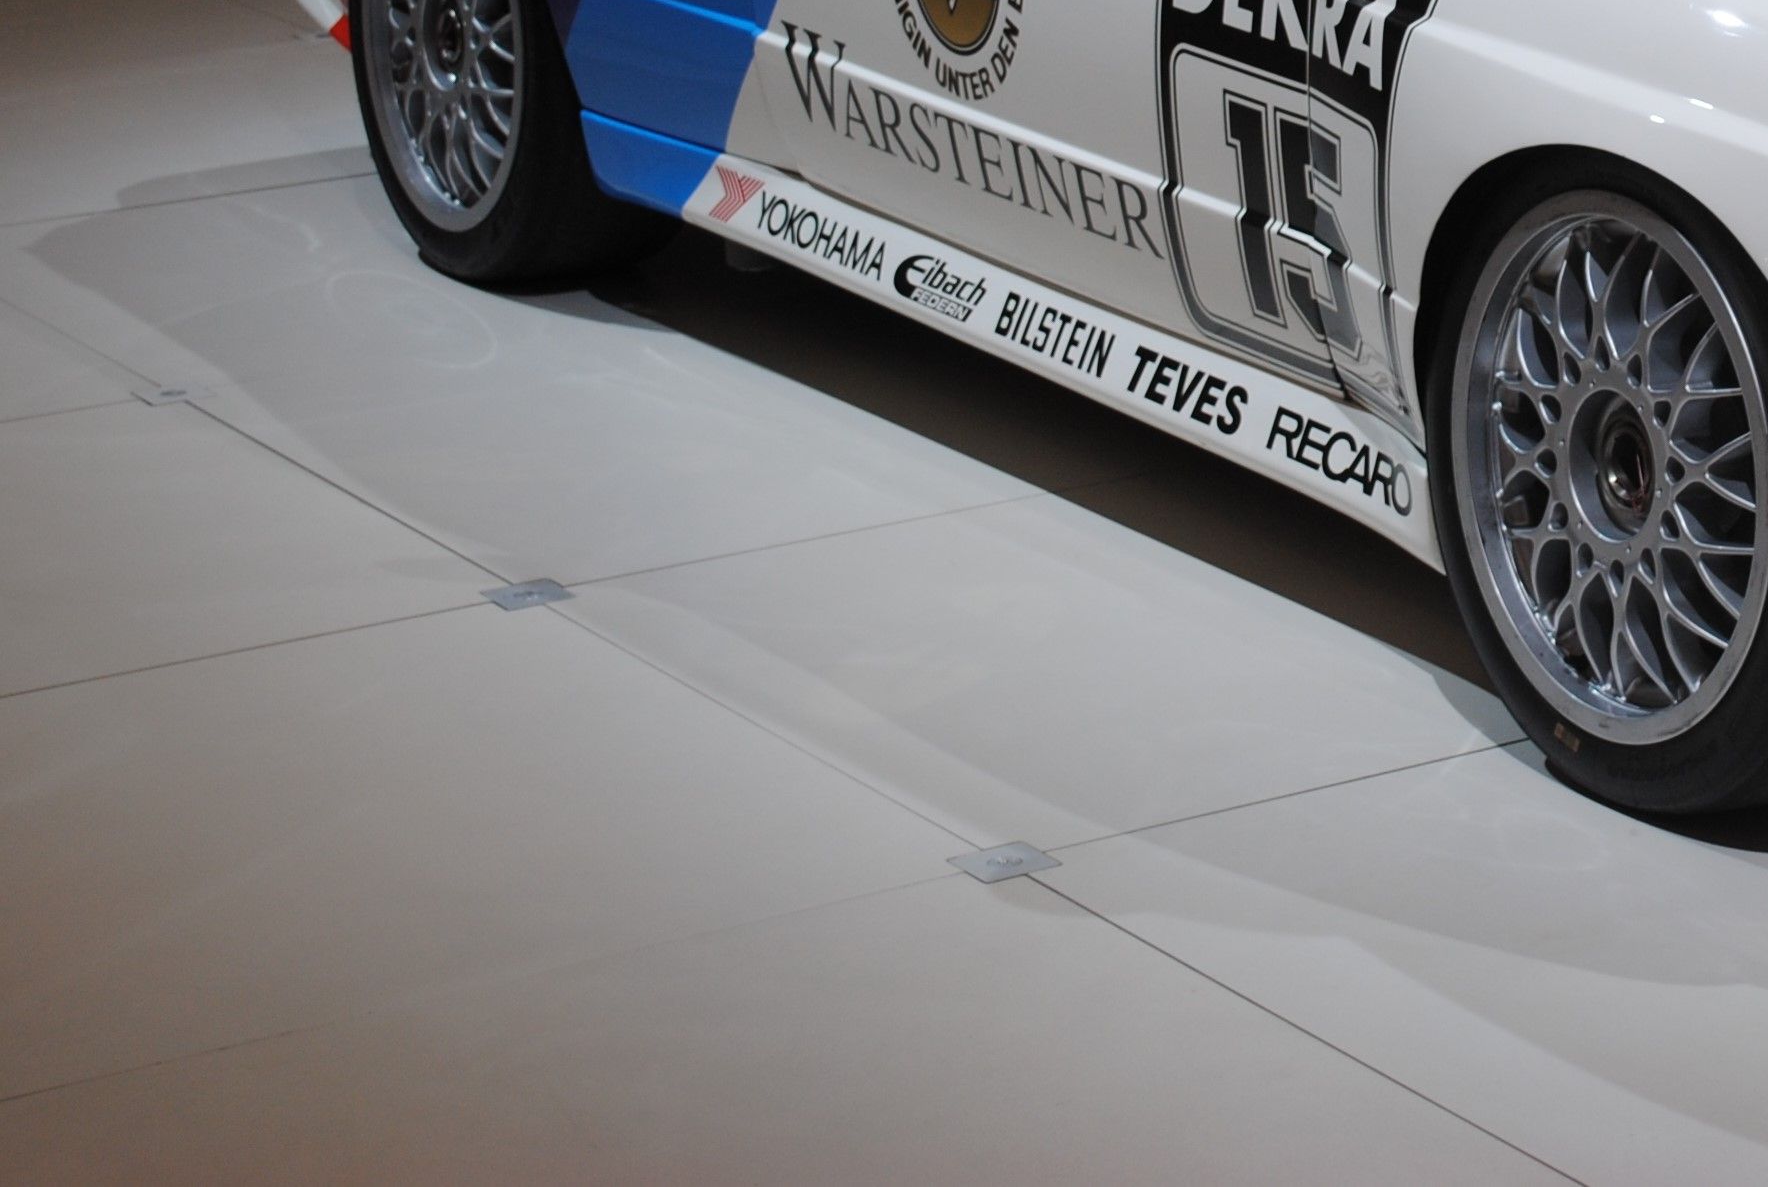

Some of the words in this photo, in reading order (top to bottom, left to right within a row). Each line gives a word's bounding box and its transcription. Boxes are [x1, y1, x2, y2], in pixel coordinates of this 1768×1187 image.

[935, 57, 995, 102] UNTER
[990, 17, 1020, 84] DEN
[780, 19, 1166, 260] WARSTEINER
[756, 190, 887, 281] YOKOHAMA
[1223, 88, 1365, 361] 15
[893, 254, 988, 308] Eibach
[911, 286, 970, 322] FEDERN
[995, 292, 1117, 379] BILSTEIN
[1126, 345, 1249, 436] TEVES
[1266, 406, 1413, 517] RECARO
